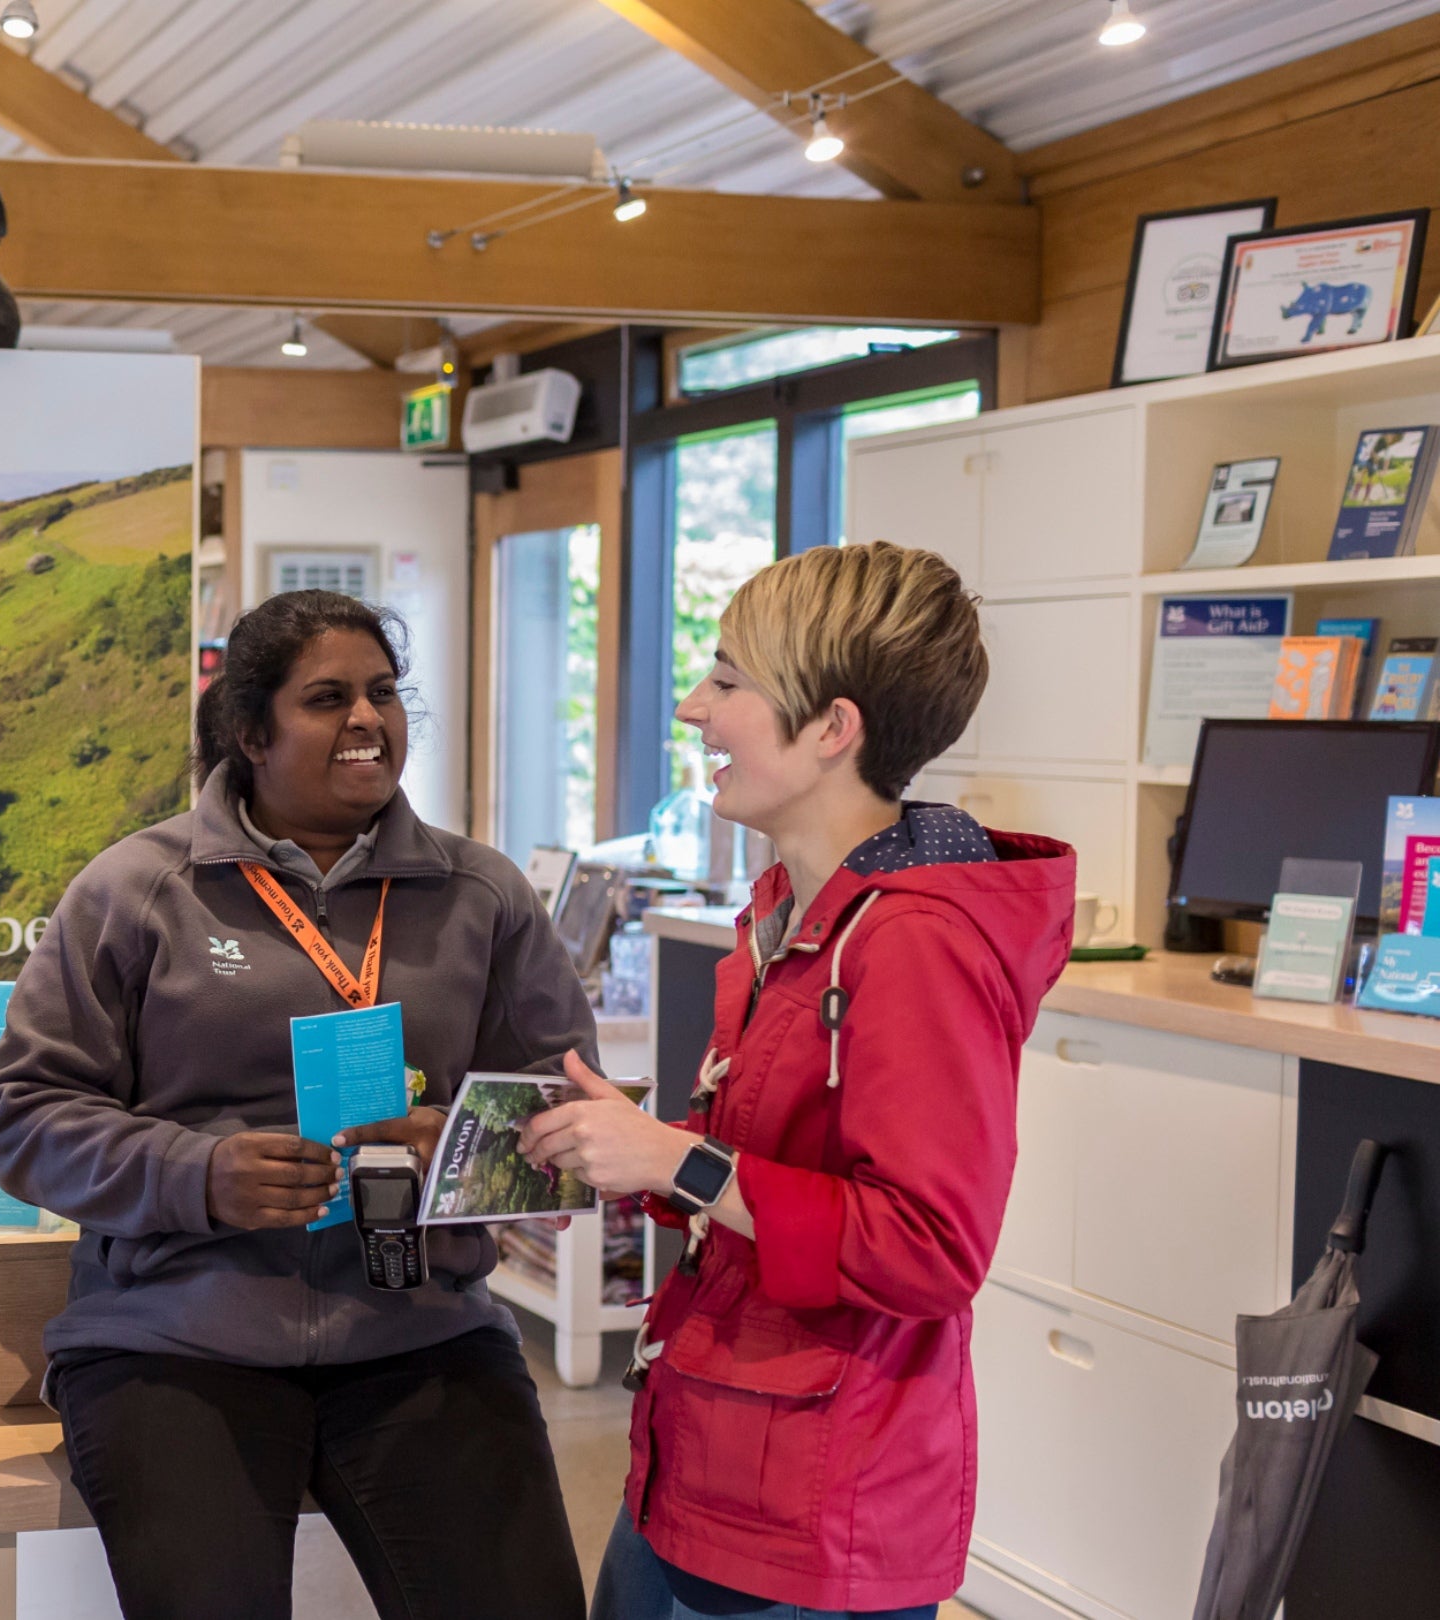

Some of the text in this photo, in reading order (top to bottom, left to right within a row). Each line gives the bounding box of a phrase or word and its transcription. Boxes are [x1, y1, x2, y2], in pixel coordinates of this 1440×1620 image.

[1209, 604, 1246, 618] What
[276, 899, 294, 922] Your
[212, 961, 251, 970] National
[313, 942, 350, 992] Thank you
[365, 950, 376, 980] Thank
[445, 1119, 475, 1179] Devon
